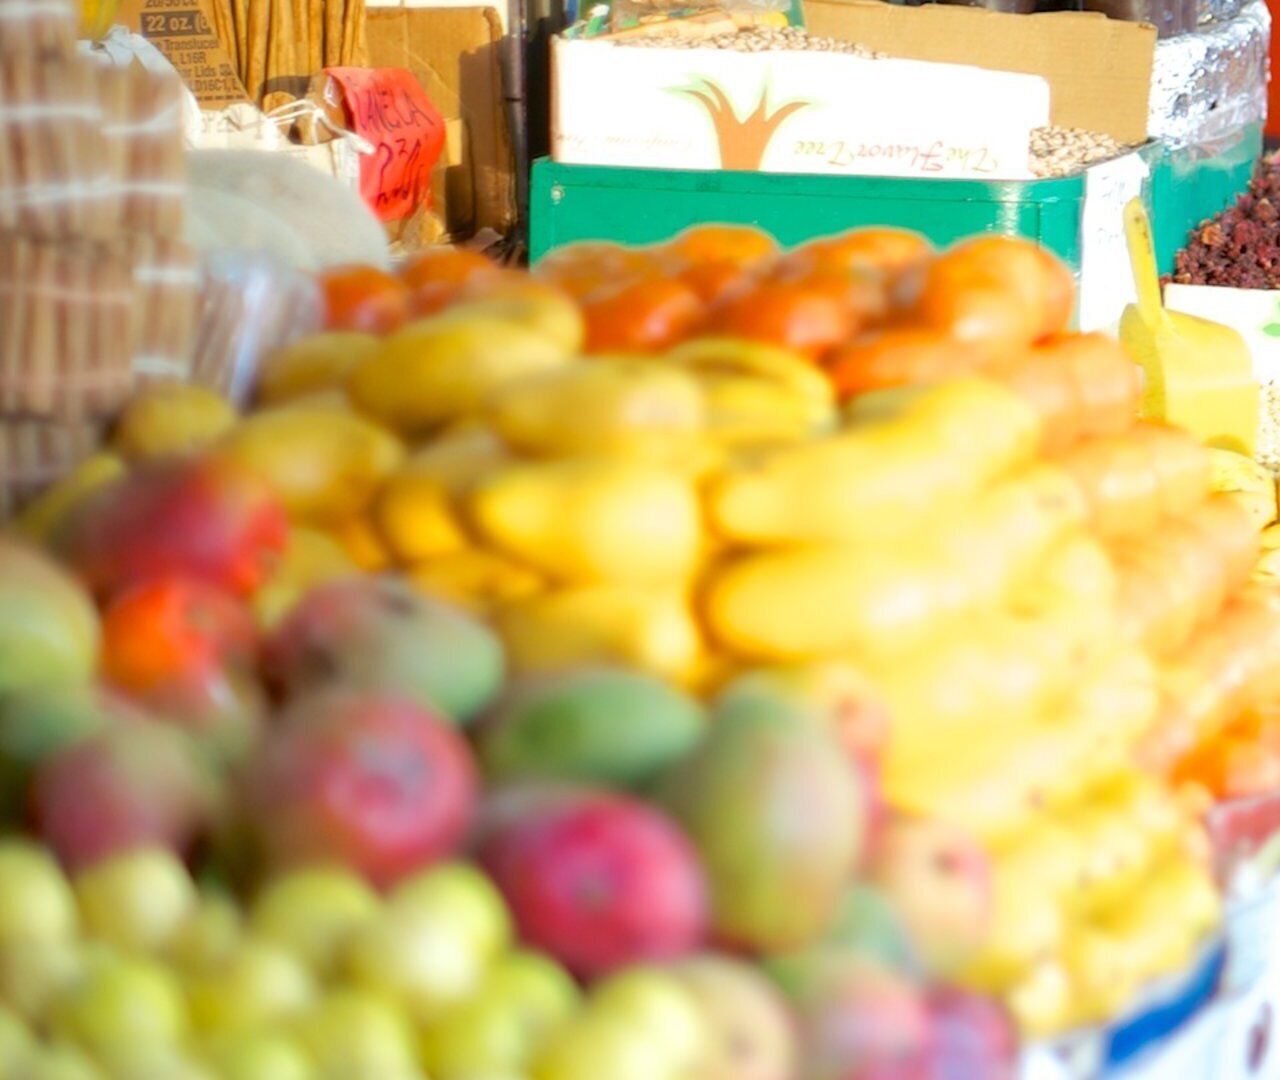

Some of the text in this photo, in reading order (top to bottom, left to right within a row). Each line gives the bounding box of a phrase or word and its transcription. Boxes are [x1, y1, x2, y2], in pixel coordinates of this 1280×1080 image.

[146, 15, 166, 32] 22
[170, 18, 193, 31] oz.
[794, 140, 999, 174] The Flavor Tree
